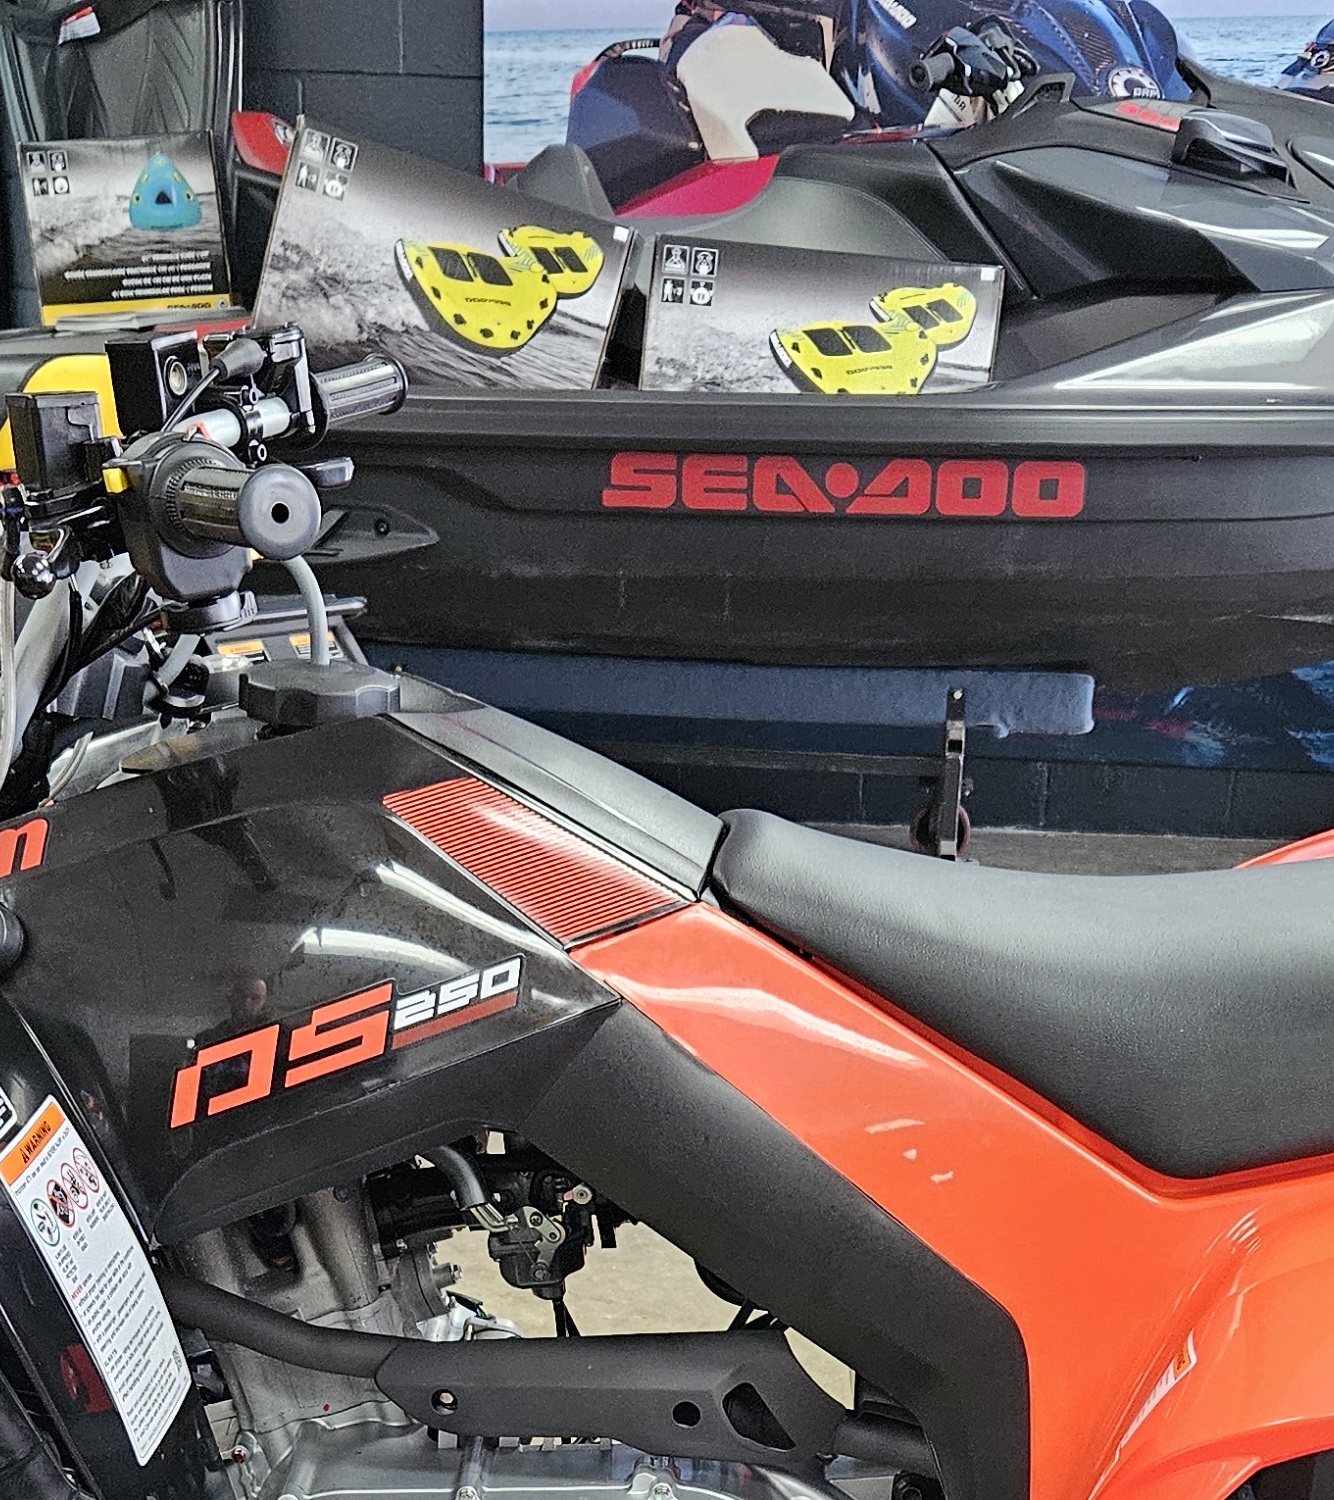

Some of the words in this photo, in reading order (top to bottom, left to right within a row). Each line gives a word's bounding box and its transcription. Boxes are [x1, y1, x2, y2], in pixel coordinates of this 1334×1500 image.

[170, 983, 393, 1129] DS
[394, 957, 521, 1030] 250
[26, 1120, 52, 1156] WARNING
